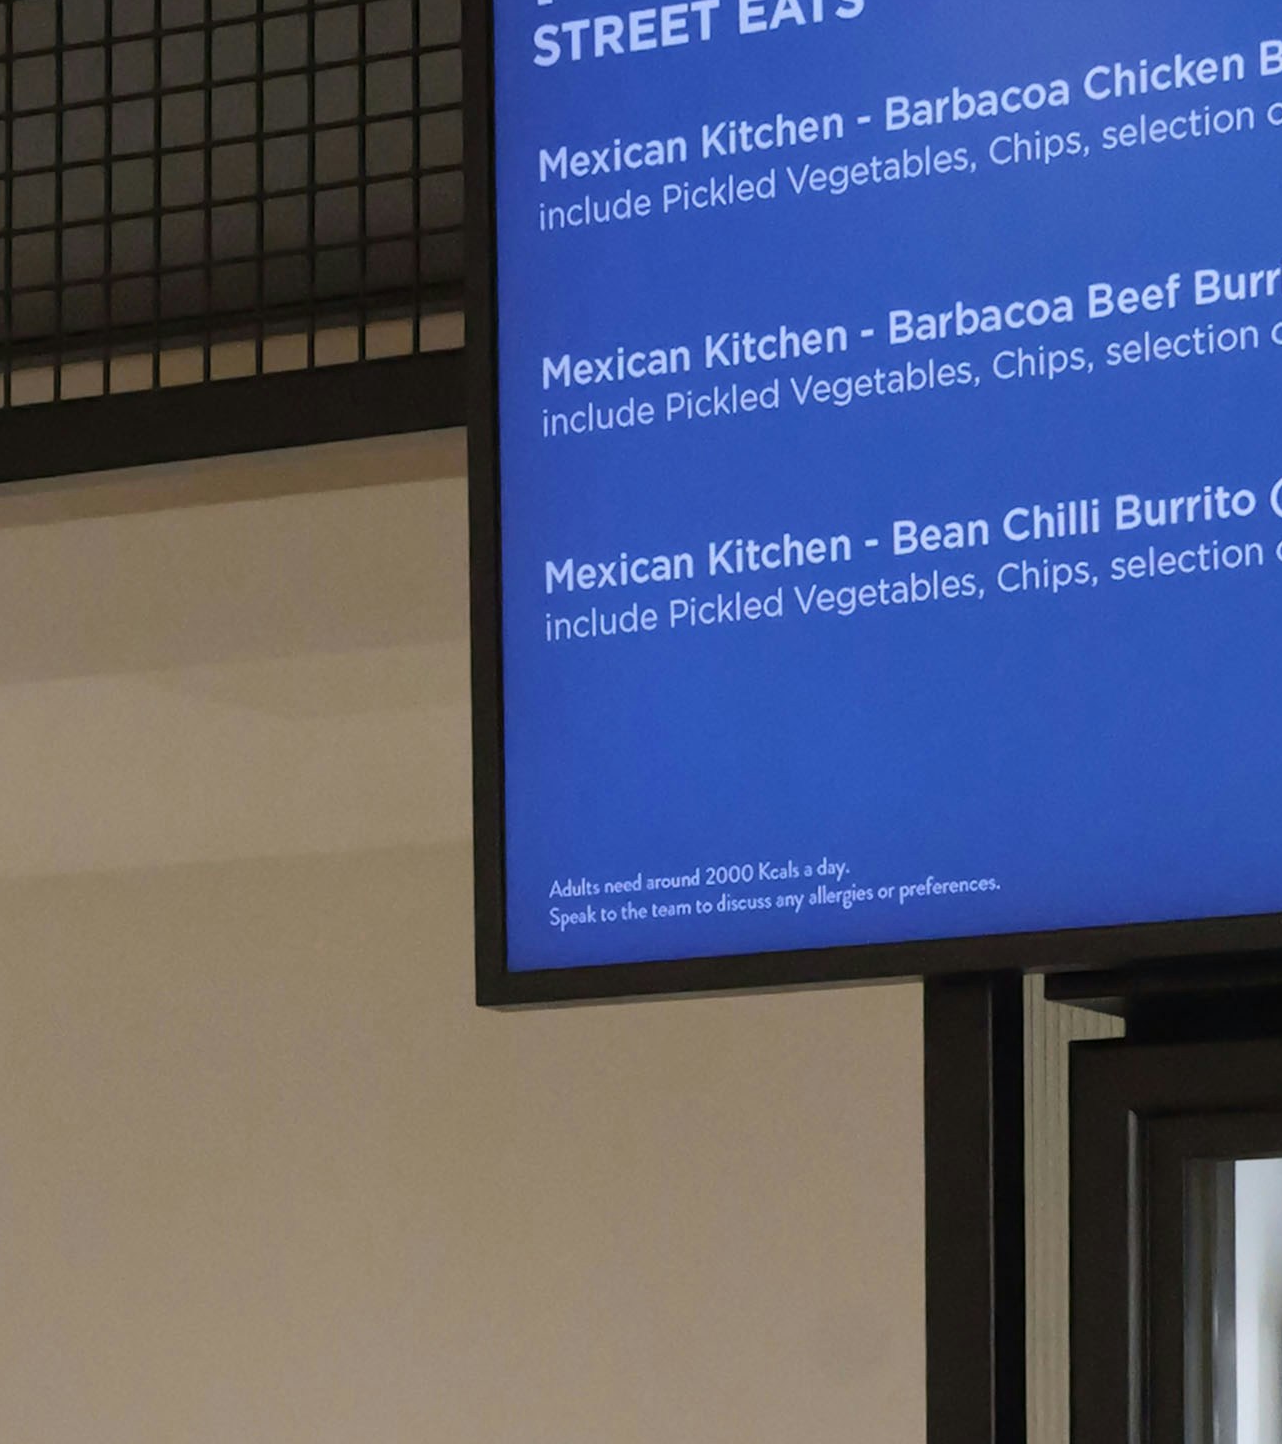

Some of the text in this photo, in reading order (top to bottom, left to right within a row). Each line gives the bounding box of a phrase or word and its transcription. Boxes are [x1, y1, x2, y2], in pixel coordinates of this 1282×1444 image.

[540, 137, 686, 181] Mexican
[703, 113, 843, 158] Kitchen
[886, 79, 1069, 130] Barbacoa
[1084, 54, 1244, 100] Chicken
[540, 190, 651, 230] include
[664, 169, 775, 212] Pickled
[787, 146, 976, 194] Vegetables,
[989, 131, 1089, 165] Chips,
[1103, 106, 1254, 149] selection
[543, 347, 690, 389] Mexican
[706, 326, 846, 368] Kitchen
[890, 296, 1073, 344] Barbacoa
[1089, 273, 1180, 318] Beef
[543, 398, 654, 436] include
[667, 379, 779, 421] Pickled
[791, 359, 980, 406] Vegetables,
[993, 346, 1093, 379] Chips,
[1107, 324, 1258, 365] selection
[546, 553, 693, 593] Mexican
[709, 534, 850, 575] Kitchen
[894, 520, 988, 555] Bean
[1003, 499, 1099, 541] Chilli
[1116, 486, 1256, 530] Burrito
[546, 603, 657, 641] include
[670, 587, 782, 628] Pickled
[794, 570, 984, 615] Vegetables,
[998, 559, 1097, 593] Chips,
[1111, 540, 1263, 580] selection
[549, 856, 850, 898] Adults need around 2000 Kcals a day.
[549, 875, 1001, 932] Speak to the team to discuss any allergies or preferences.
